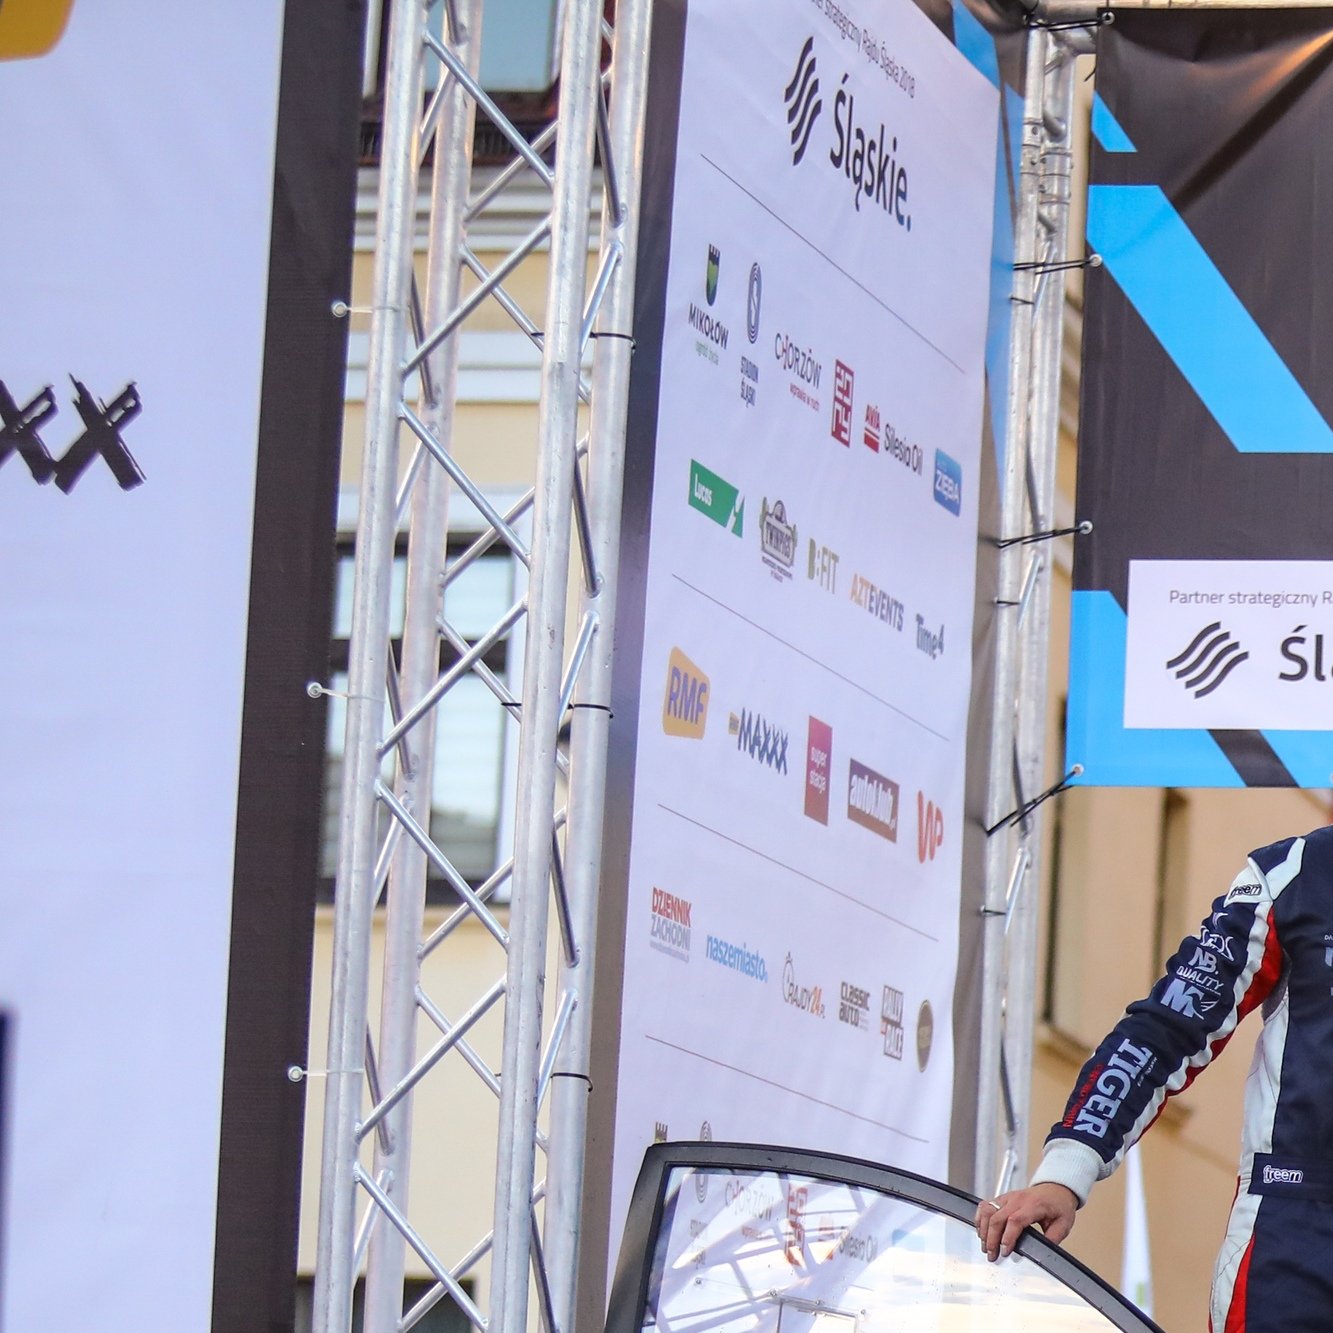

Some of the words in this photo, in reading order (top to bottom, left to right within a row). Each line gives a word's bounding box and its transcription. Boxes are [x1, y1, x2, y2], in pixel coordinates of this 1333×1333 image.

[830, 73, 912, 232] Śląskie.
[688, 303, 729, 350] MIKOŁÓW
[774, 332, 822, 389] CHORZÓW
[884, 423, 910, 467] Silesia
[1169, 590, 1225, 605] Partner
[1227, 590, 1318, 608] strategiczny
[667, 666, 708, 725] RMF
[737, 707, 789, 777] MAXXX
[652, 886, 691, 928] DZIENNIK
[650, 913, 691, 951] ZACHODNI
[1176, 966, 1225, 990] QUALITY
[1073, 1038, 1154, 1139] TIGER
[1263, 1165, 1304, 1185] freem
